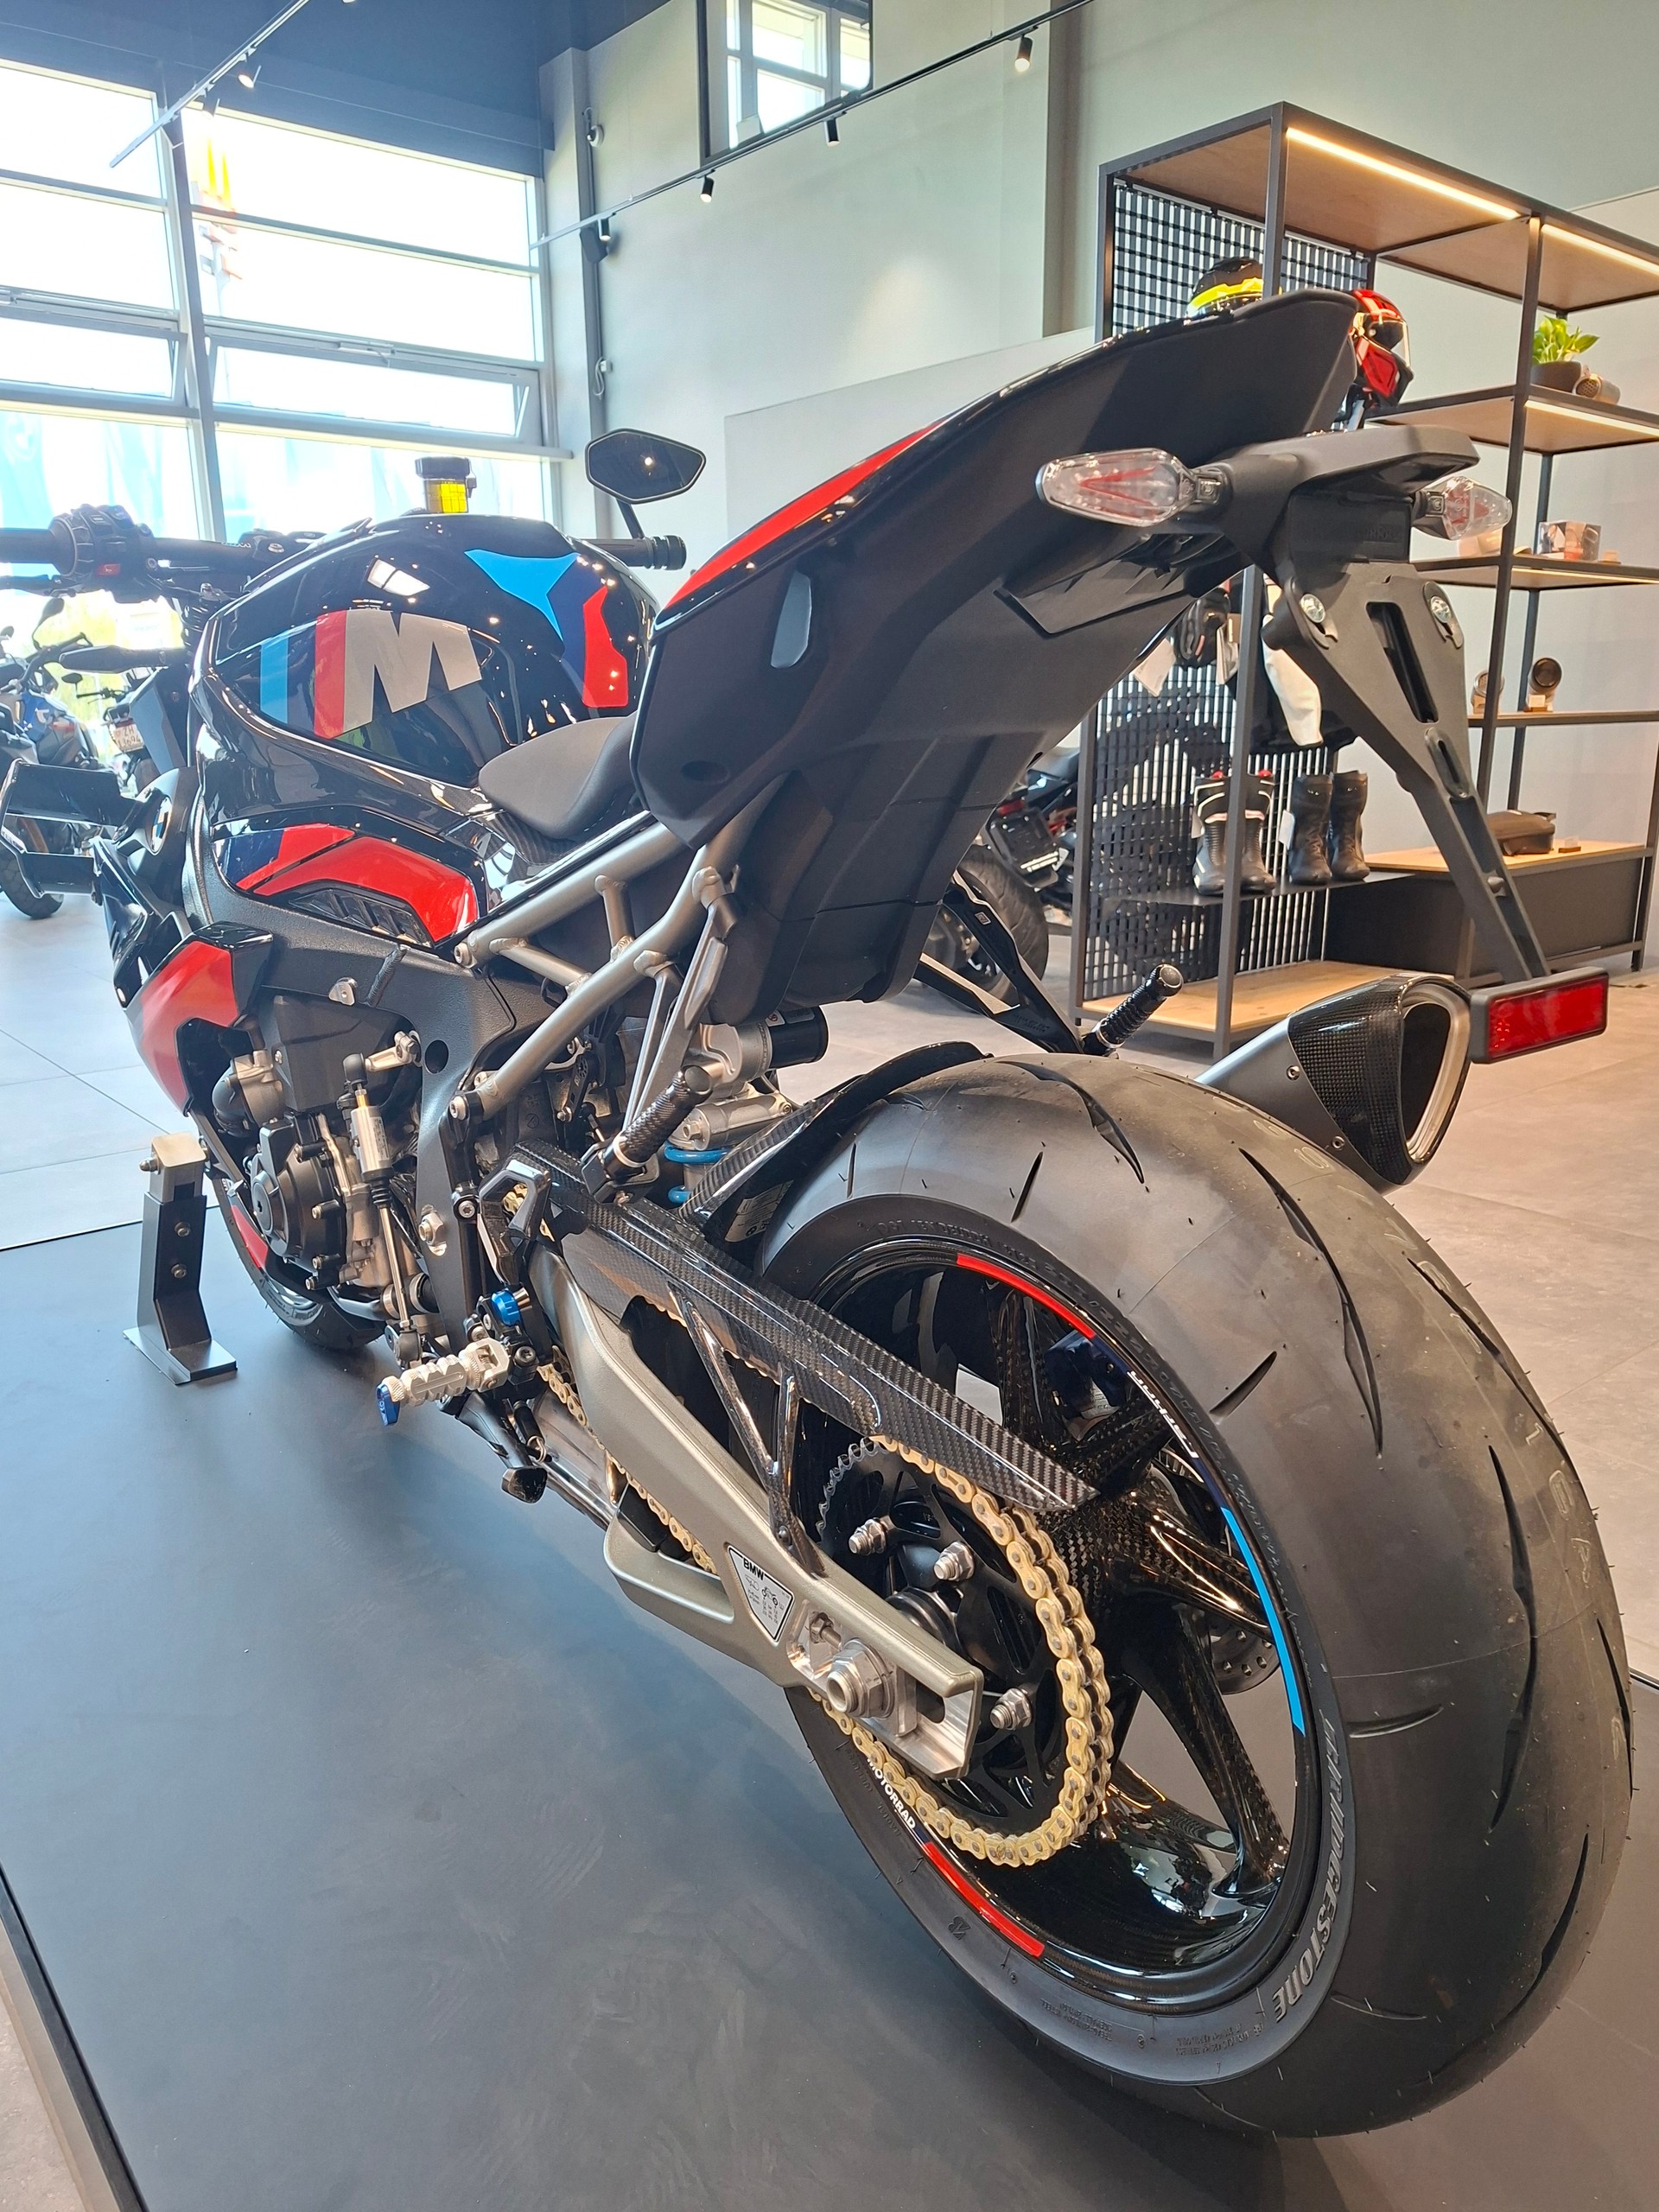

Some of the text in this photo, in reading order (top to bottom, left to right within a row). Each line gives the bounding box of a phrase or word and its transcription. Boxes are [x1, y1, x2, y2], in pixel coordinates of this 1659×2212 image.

[342, 608, 482, 735] M
[124, 726, 135, 737] ZH
[743, 1557, 765, 1581] BMW
